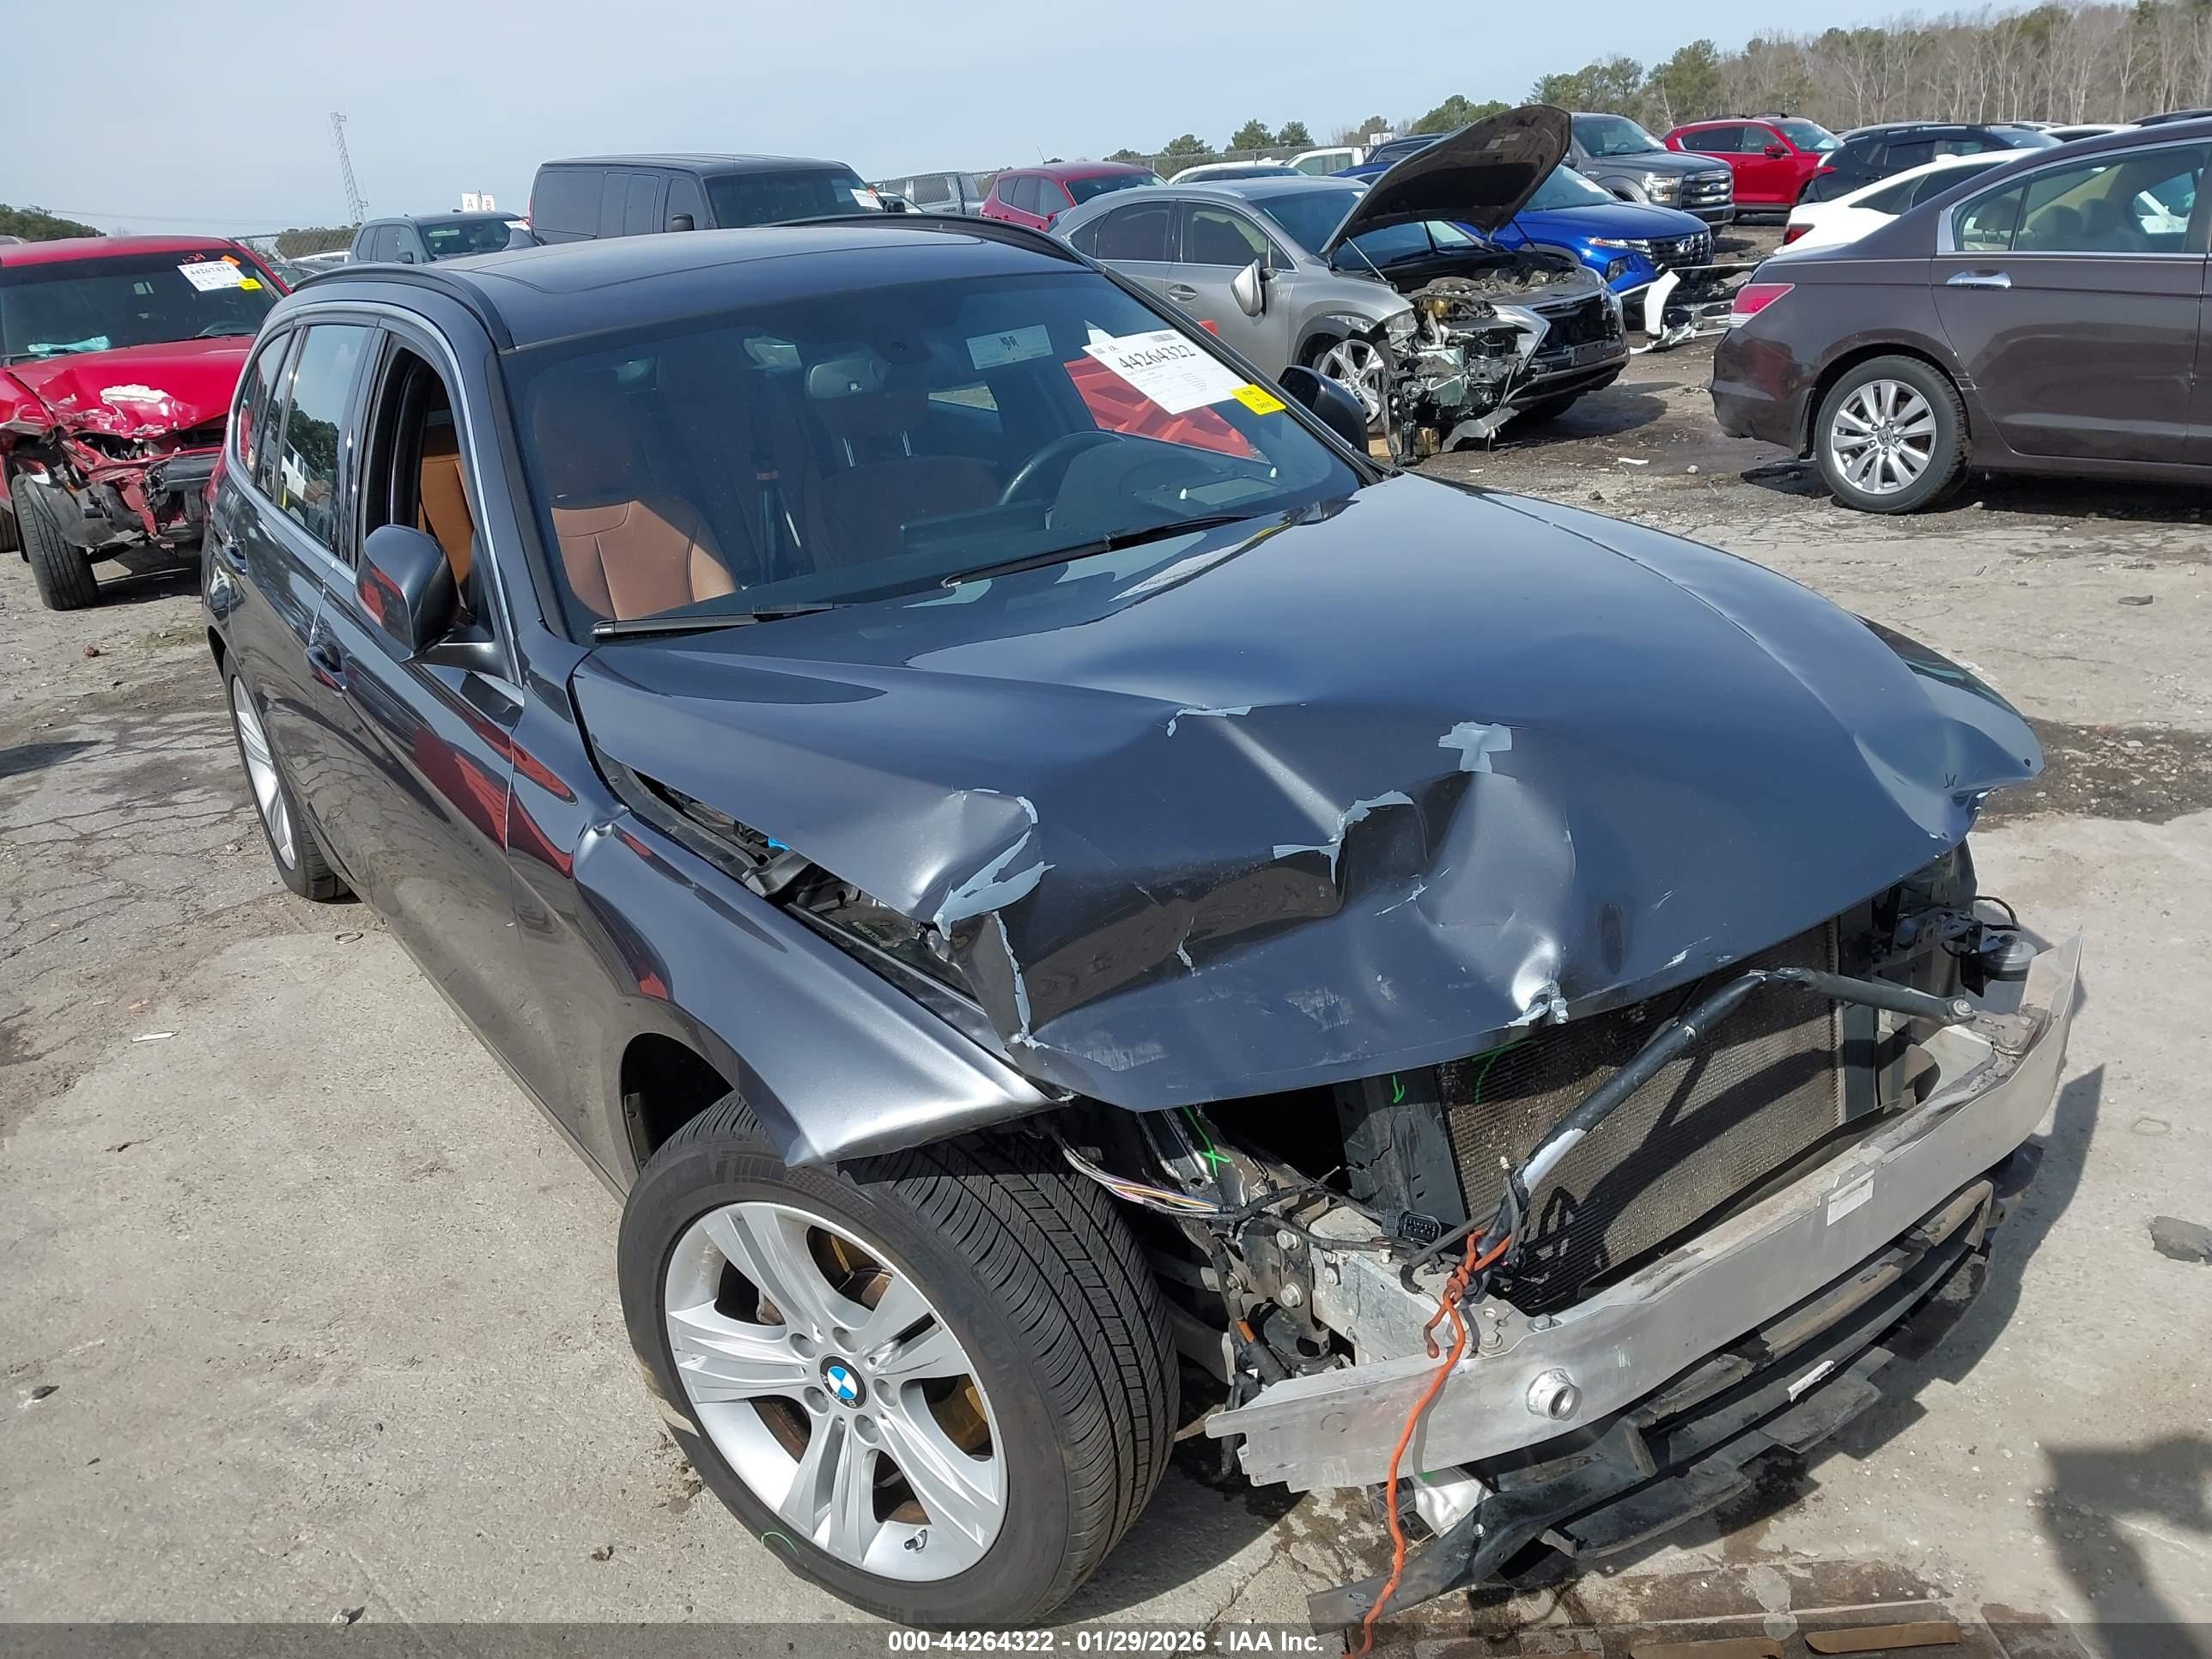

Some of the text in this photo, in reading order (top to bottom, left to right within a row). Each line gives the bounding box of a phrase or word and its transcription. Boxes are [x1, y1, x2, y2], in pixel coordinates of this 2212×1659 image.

[467, 198, 474, 209] A
[485, 199, 492, 210] B
[1119, 344, 1196, 369] 44264322
